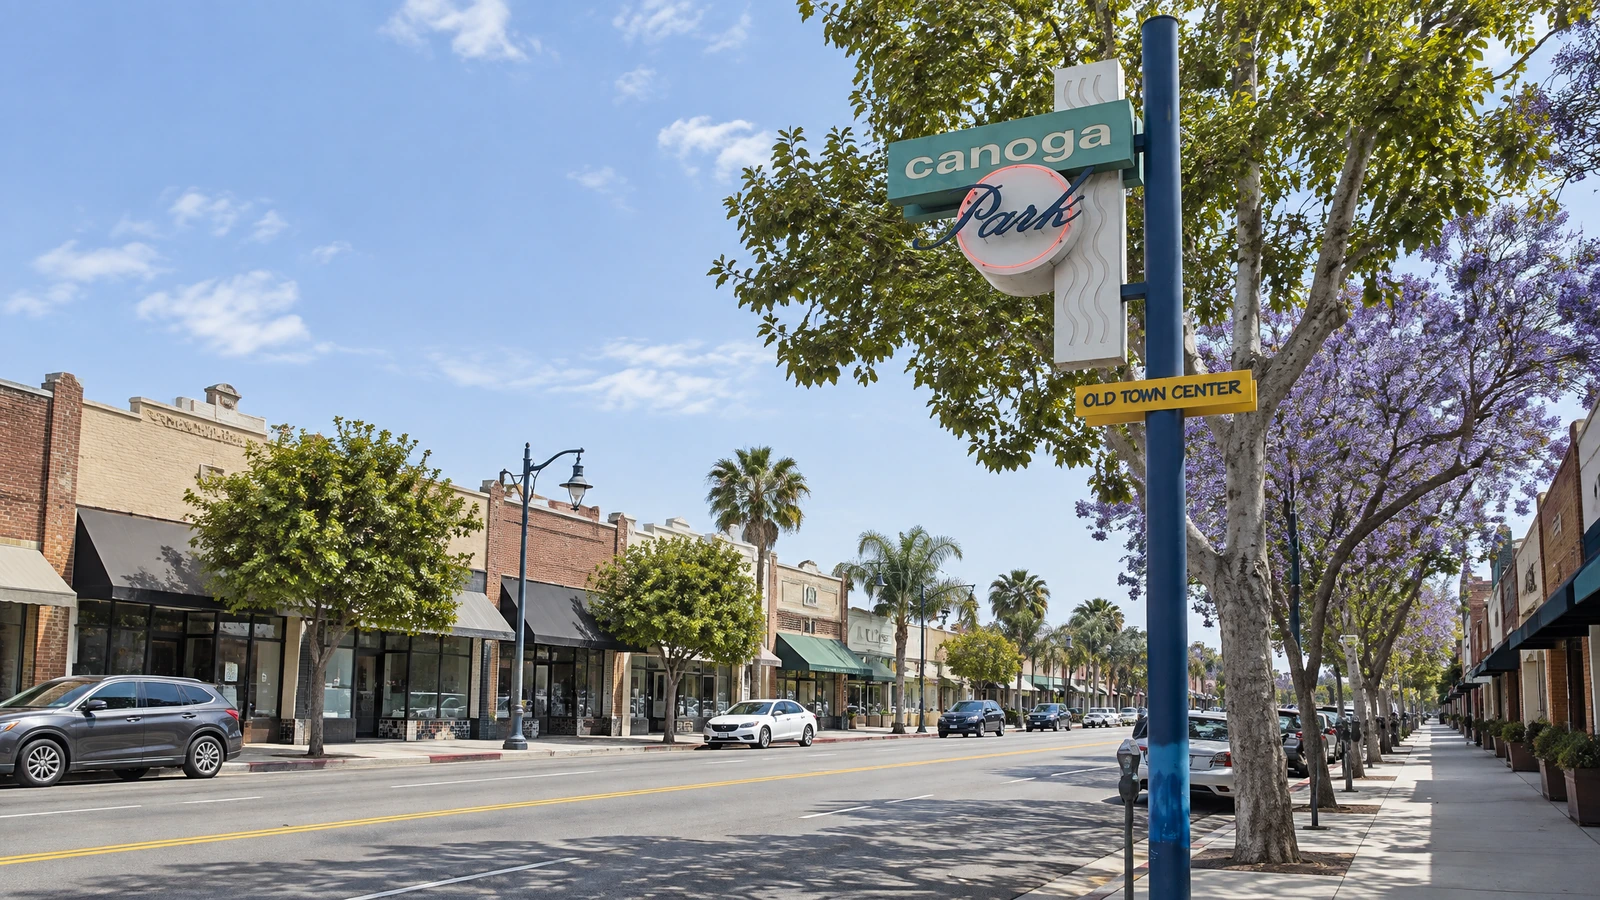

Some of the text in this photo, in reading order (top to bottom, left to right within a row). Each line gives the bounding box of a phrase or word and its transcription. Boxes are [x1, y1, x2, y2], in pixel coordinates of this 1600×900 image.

[904, 123, 1111, 180] canoga
[912, 166, 1095, 250] Park
[1083, 379, 1242, 408] OLD TOWN CENTER
